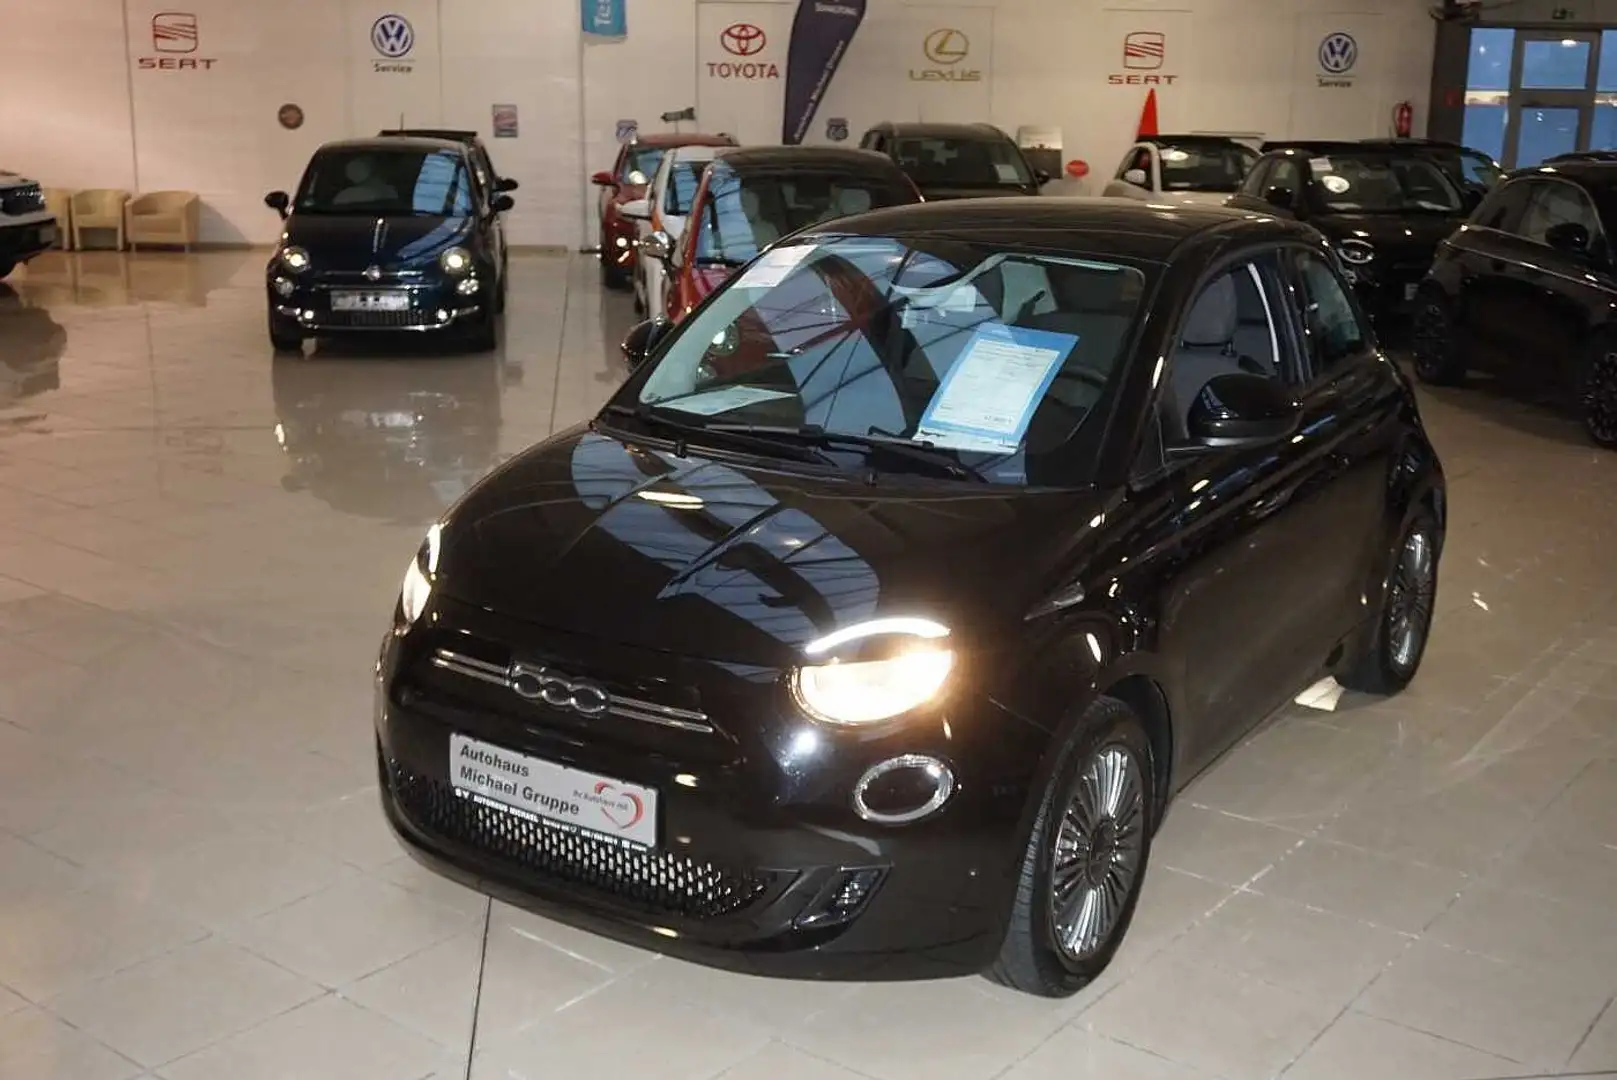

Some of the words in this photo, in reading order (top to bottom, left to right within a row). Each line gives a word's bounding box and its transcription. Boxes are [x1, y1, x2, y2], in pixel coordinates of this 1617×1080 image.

[138, 58, 218, 70] SEAT
[706, 62, 779, 79] TOYOTA
[909, 69, 981, 82] LEXUS
[1108, 74, 1178, 85] SEAT
[460, 744, 529, 777] Autohaus
[460, 765, 518, 796] Michael
[522, 785, 579, 815] Gruppe
